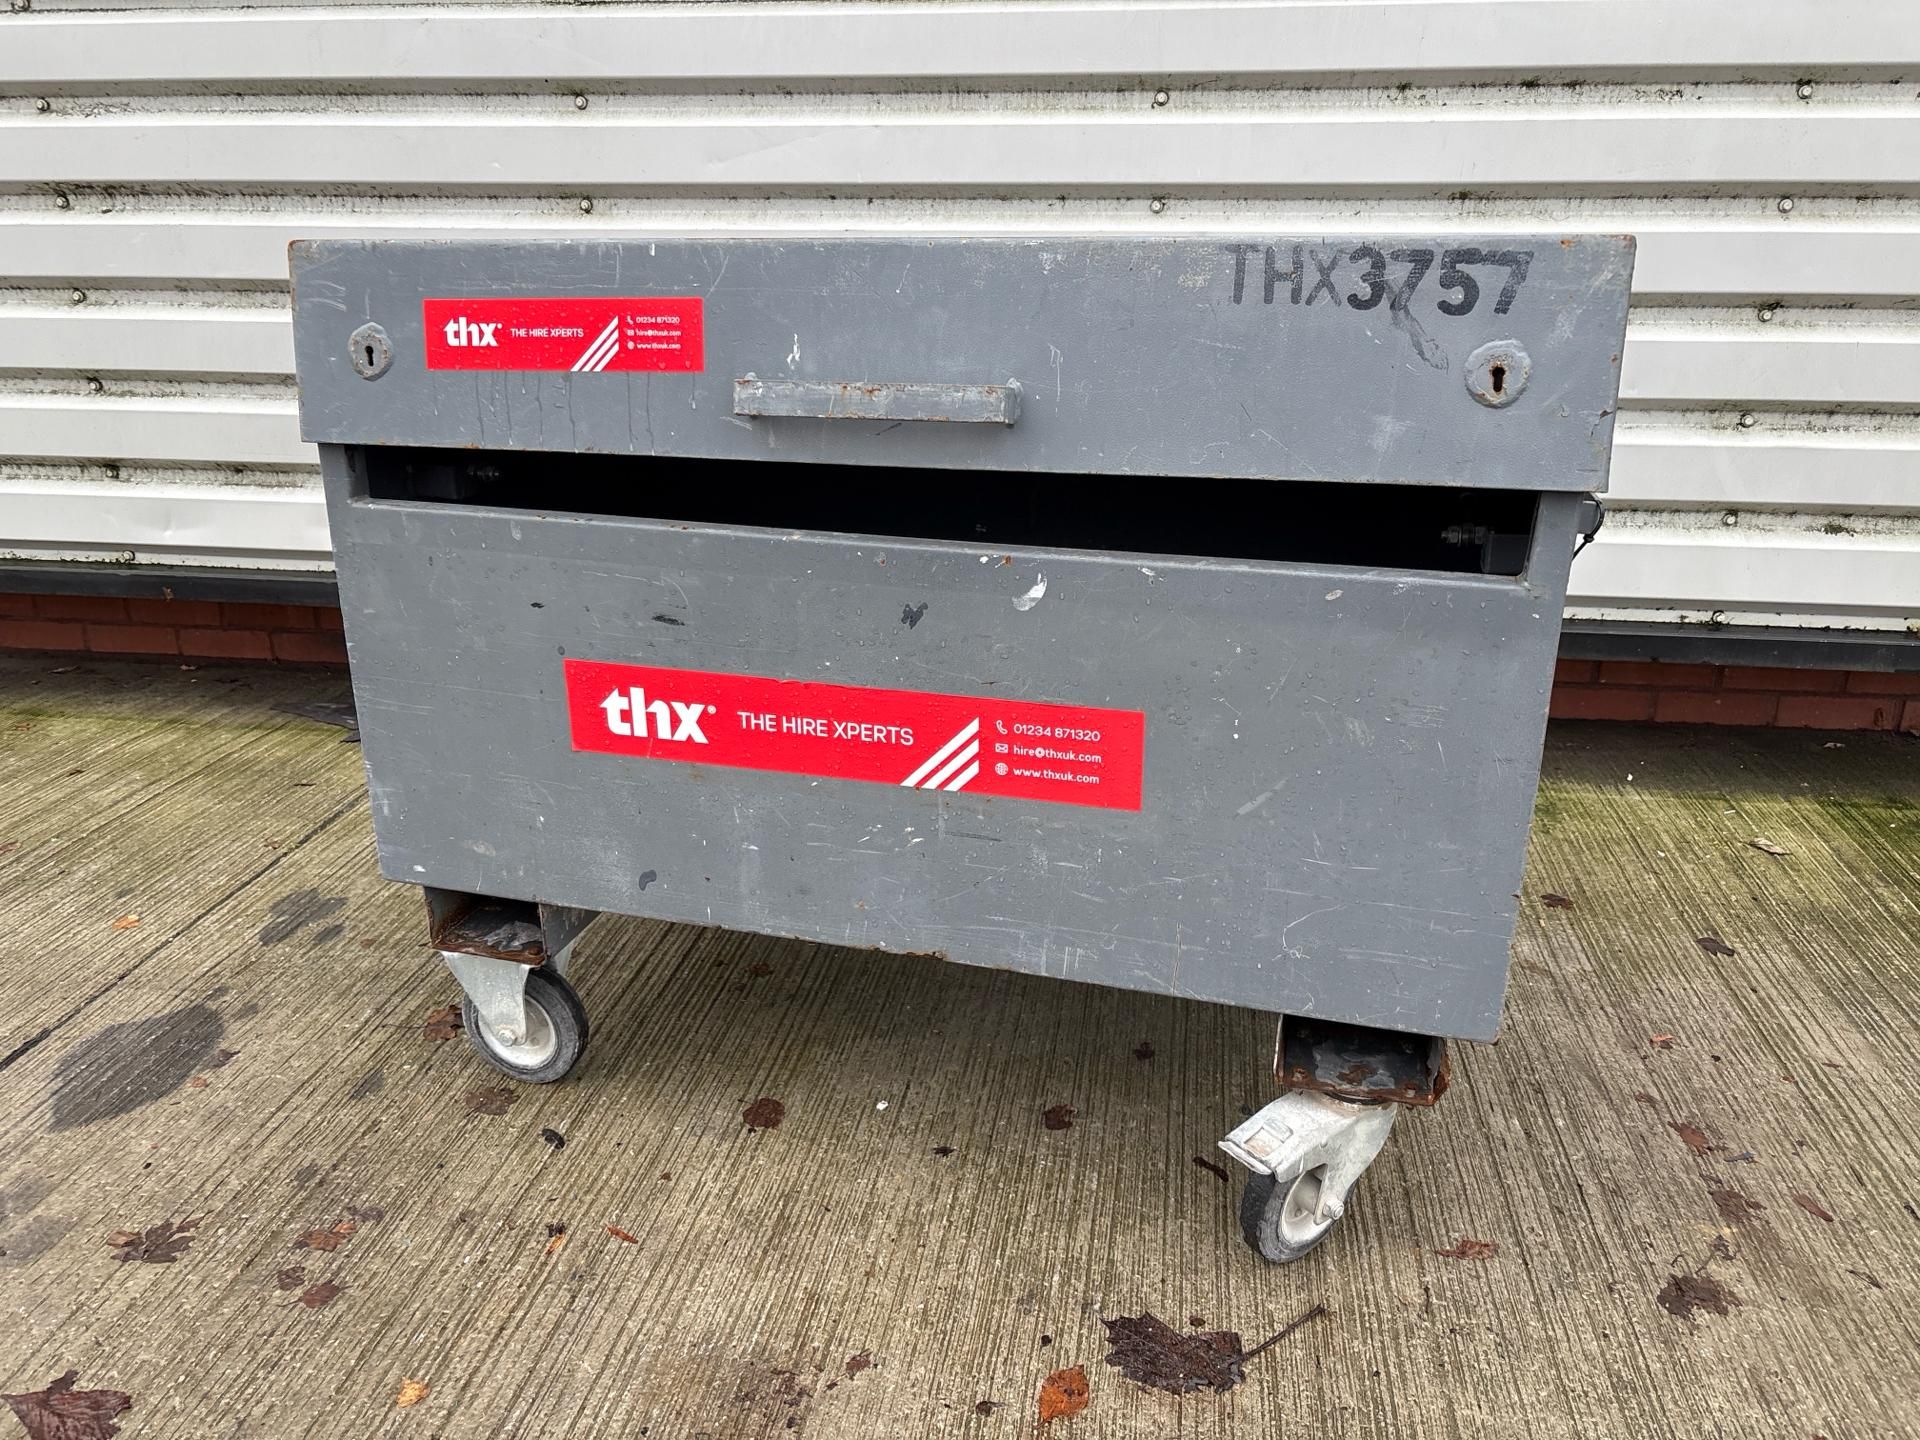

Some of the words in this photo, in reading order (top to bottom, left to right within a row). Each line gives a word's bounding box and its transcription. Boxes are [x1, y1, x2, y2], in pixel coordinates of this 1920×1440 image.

[1226, 245, 1534, 316] THX3757
[635, 316, 656, 324] 01234
[656, 316, 680, 325] 871320
[510, 327, 528, 338] THE
[528, 327, 549, 338] HIRE
[550, 327, 584, 338] XPERTS
[635, 328, 682, 337] hire@thxuk.com
[636, 341, 681, 350] www.thxuk.com
[737, 711, 777, 732] THE
[782, 715, 829, 737] HIRE
[833, 720, 914, 746] XPERTS
[1013, 723, 1052, 737] 01234
[1054, 727, 1101, 742] 871320
[1013, 744, 1102, 763] hire@thxuk.com
[1013, 767, 1100, 784] www.thxuk.com
